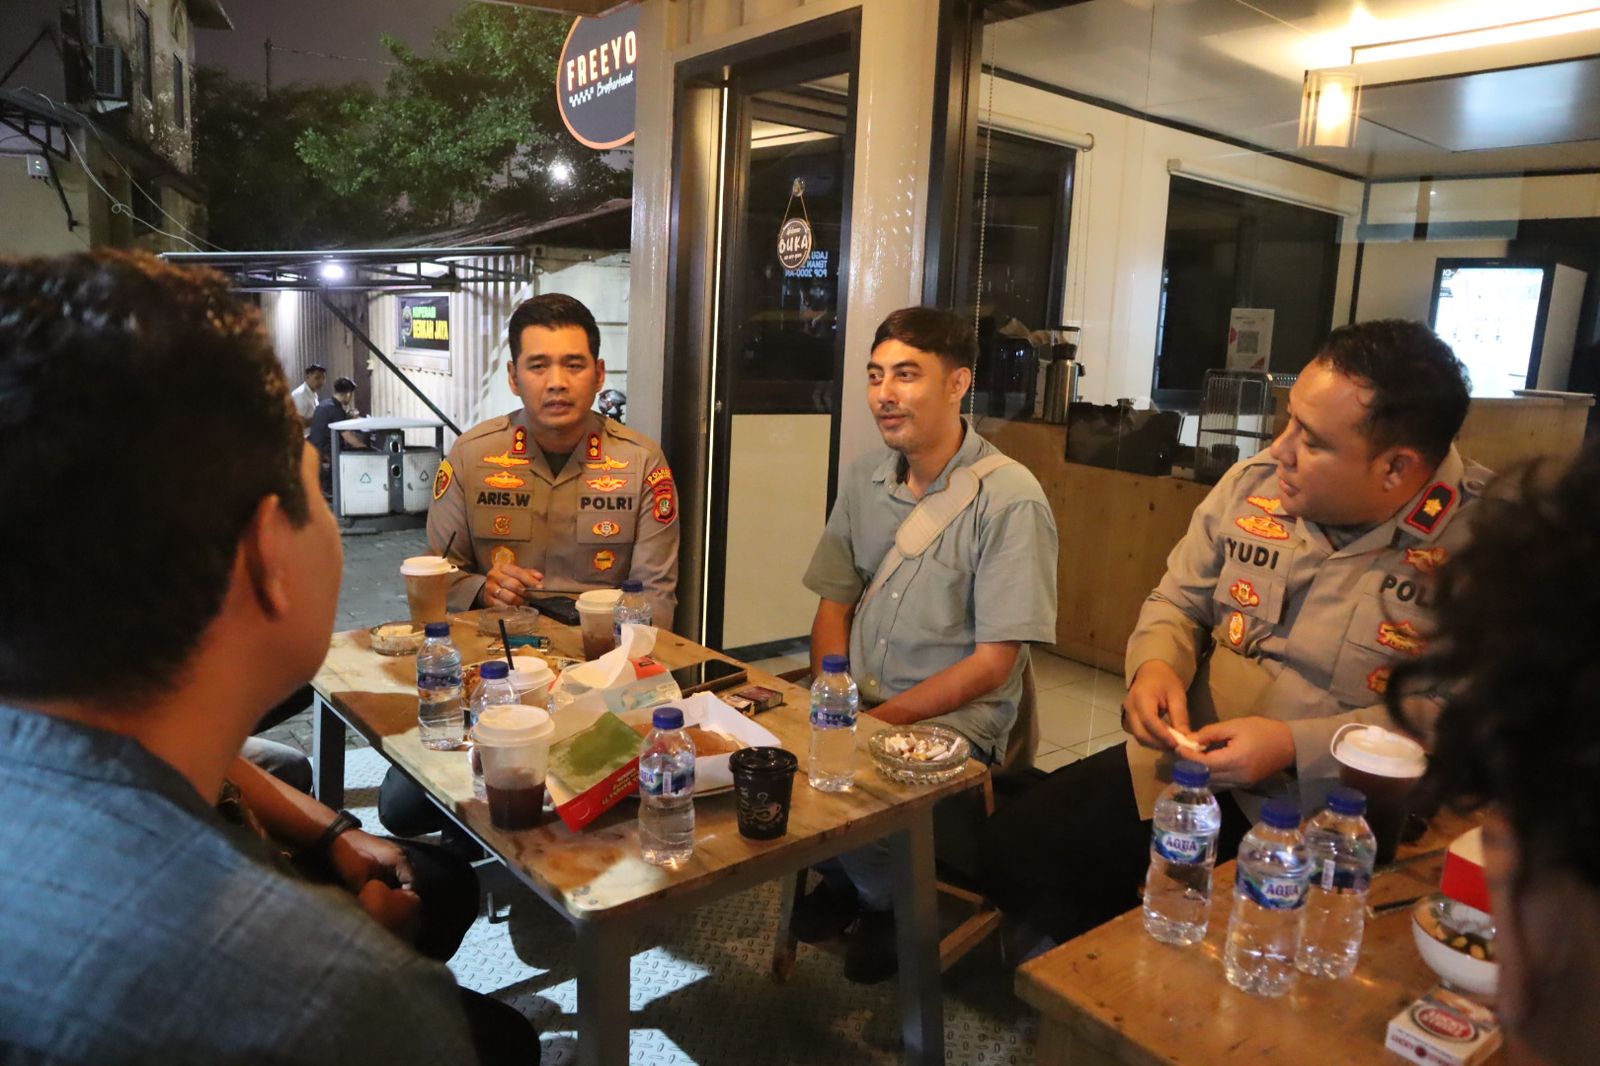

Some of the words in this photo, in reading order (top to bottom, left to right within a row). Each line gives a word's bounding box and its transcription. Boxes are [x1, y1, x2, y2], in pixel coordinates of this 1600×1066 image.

[567, 30, 637, 91] FREEYO
[477, 491, 531, 508] ARIS.W
[580, 497, 633, 510] POLRI
[1227, 538, 1280, 570] YUDI
[1165, 837, 1197, 850] AQUA
[1266, 884, 1299, 896] AQUA
